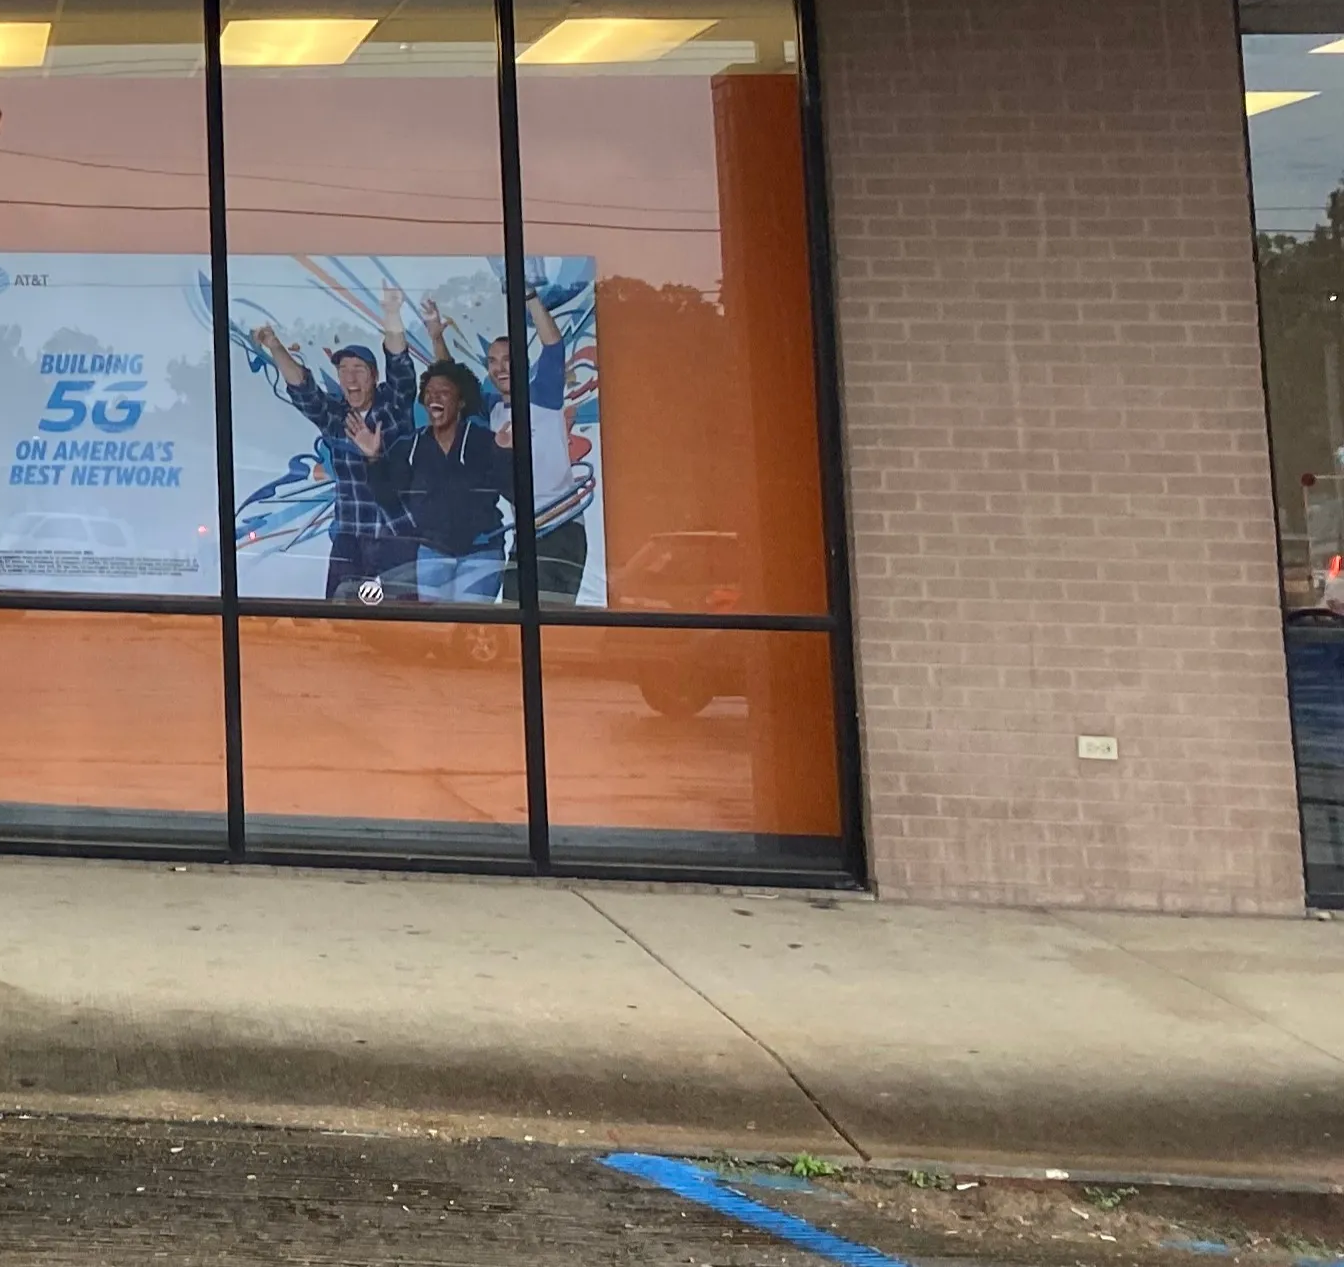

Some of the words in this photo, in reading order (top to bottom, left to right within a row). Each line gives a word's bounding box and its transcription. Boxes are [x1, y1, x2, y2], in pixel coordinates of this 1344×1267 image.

[14, 274, 50, 287] AT&T
[40, 353, 145, 375] BUILDING
[38, 380, 149, 434] 5G
[15, 440, 48, 461] ON
[52, 440, 176, 463] AMERICA'S
[9, 464, 66, 486] BEST
[70, 466, 184, 487] NETWORK
